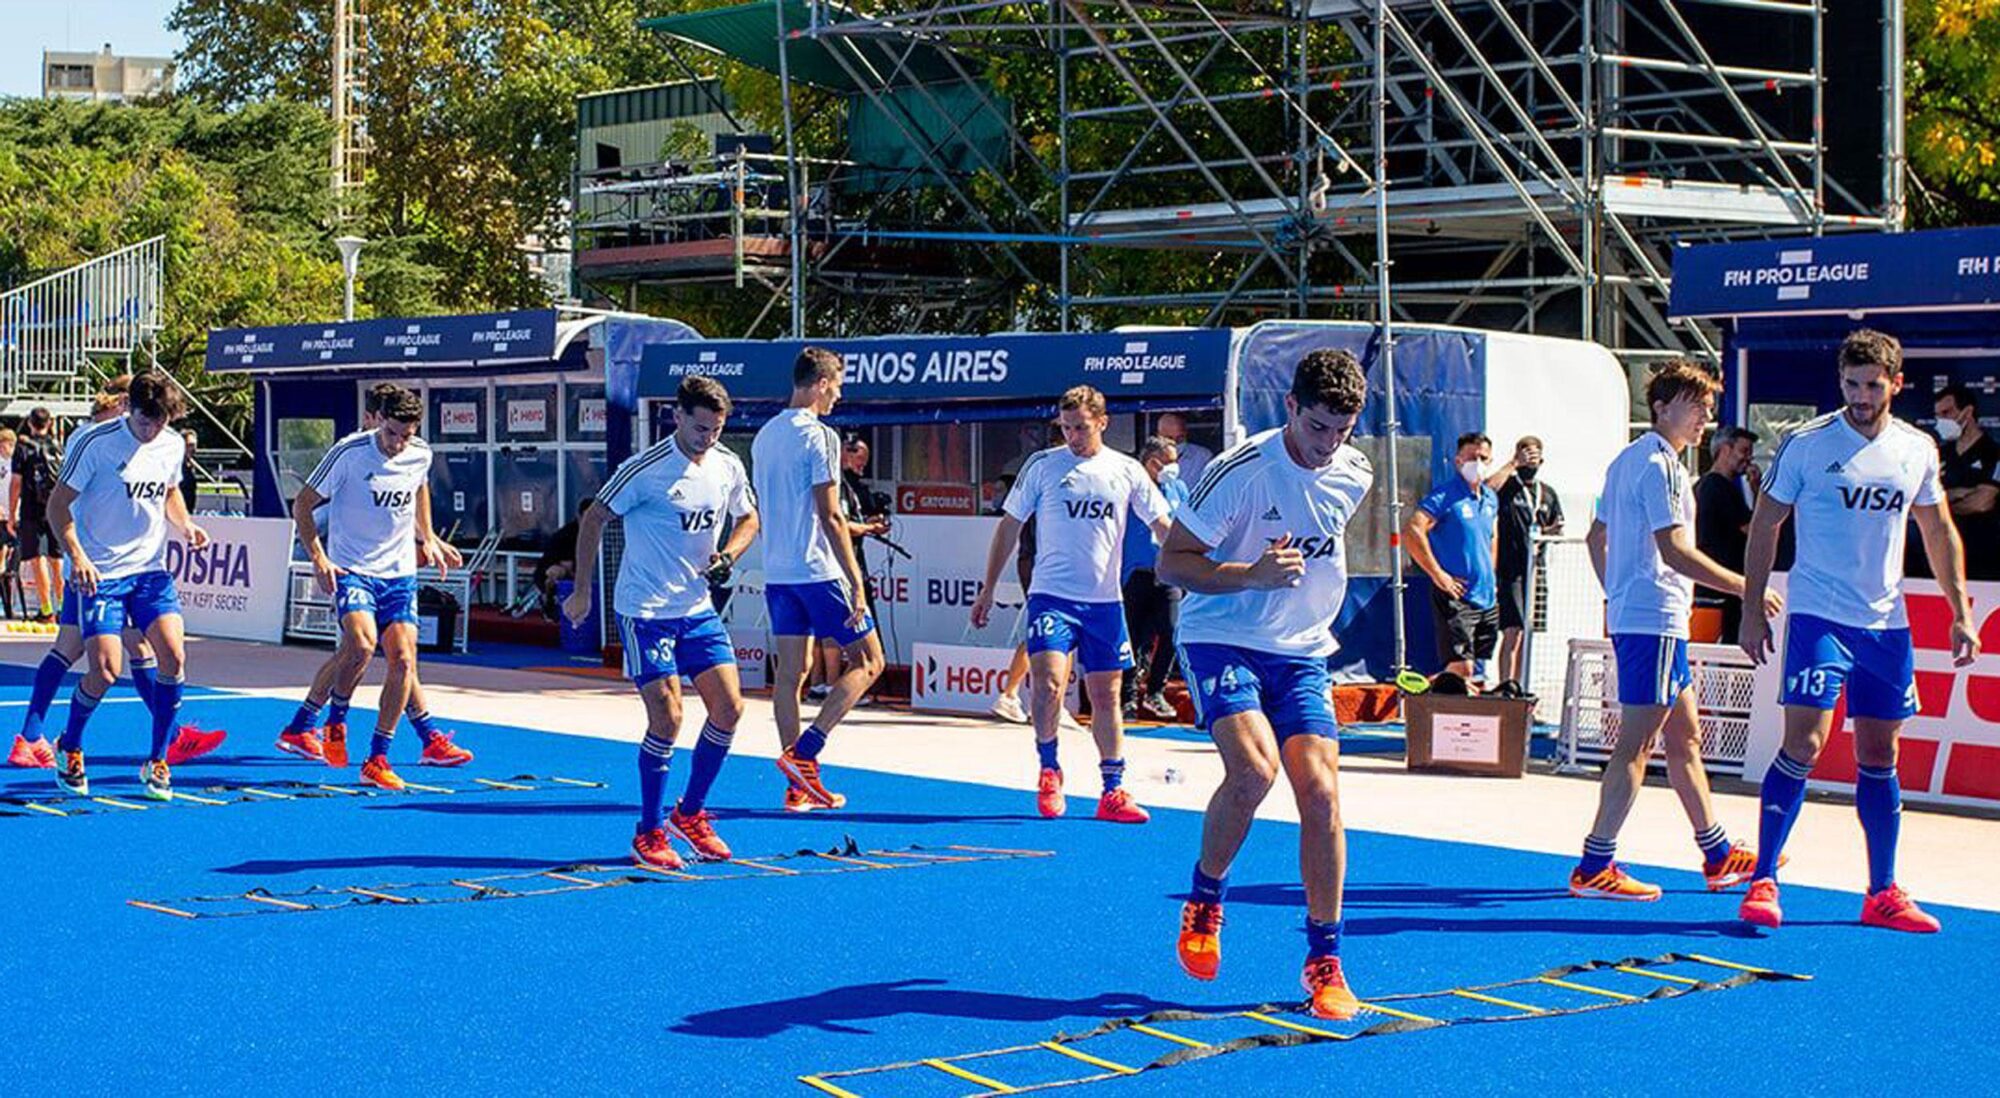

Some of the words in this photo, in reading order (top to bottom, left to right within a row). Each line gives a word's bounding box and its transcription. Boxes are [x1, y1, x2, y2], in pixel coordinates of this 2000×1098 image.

[1755, 267, 1793, 285] PRO
[1795, 263, 1869, 283] LEAGUE
[502, 329, 531, 341] LEAGUE
[706, 362, 744, 376] LEAGUE
[920, 349, 1009, 383] AIRES
[1106, 356, 1133, 371] PRO
[1134, 354, 1186, 370] LEAGUE
[123, 482, 165, 499] VISA
[1835, 485, 1904, 513] VISA
[1062, 500, 1114, 520] VISA
[166, 540, 250, 588] DISHA
[96, 600, 106, 621] 7
[1033, 615, 1055, 637] 12
[1221, 664, 1238, 691] 4
[1799, 667, 1825, 696] 13
